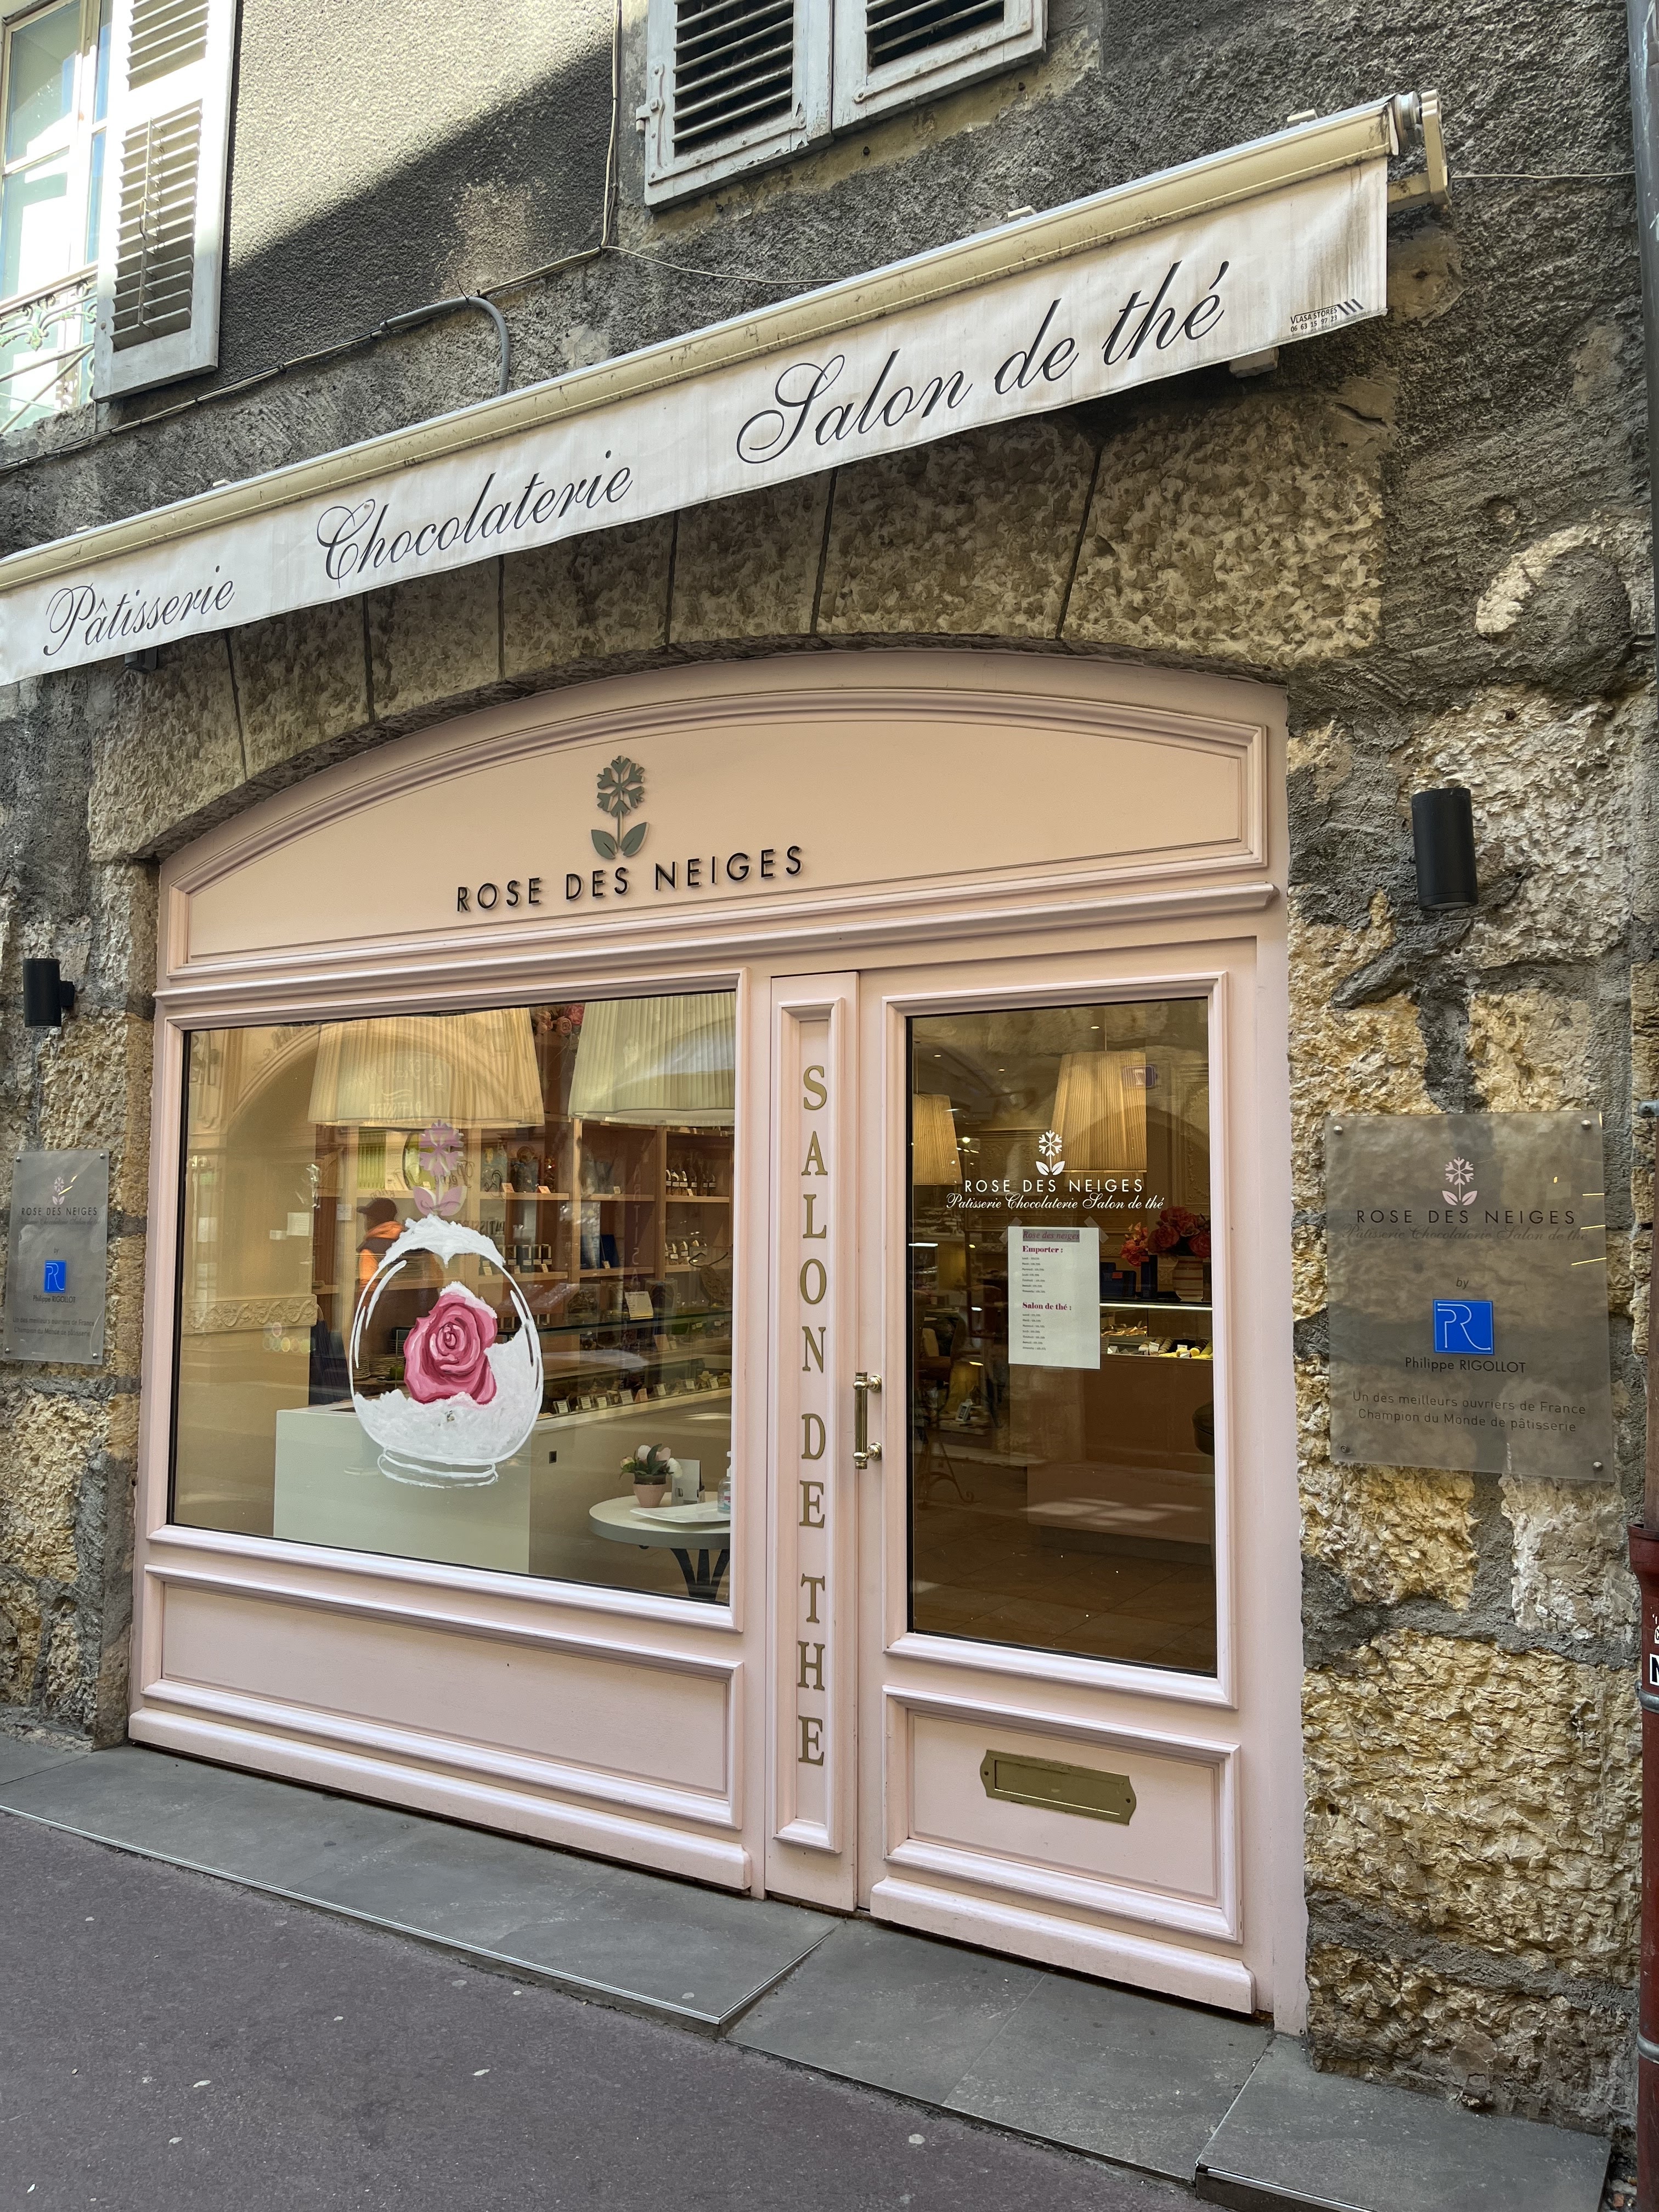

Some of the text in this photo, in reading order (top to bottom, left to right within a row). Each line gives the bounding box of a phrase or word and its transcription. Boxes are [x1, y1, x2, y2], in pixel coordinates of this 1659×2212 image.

[1313, 307, 1338, 319] STORES
[736, 259, 1229, 465] Salon de thé
[317, 450, 633, 589] Chocolaterie
[43, 565, 235, 656] Pâtisserie
[457, 845, 803, 912] ROSE DES NEIGES
[964, 1179, 1142, 1192] ROSE DES NEIGES
[946, 1192, 1165, 1210] Patisserie Chocolaterie Salon de thé
[21, 1207, 97, 1216] ROSE DES NEIGES
[1357, 1210, 1575, 1224] ROSE DES NEIGES
[1057, 1233, 1079, 1241] neiges
[1409, 1223, 1492, 1239] Chocolaterie
[1497, 1224, 1543, 1240] Salon
[1548, 1227, 1563, 1240] de
[1023, 1245, 1059, 1254] Emporter
[1456, 1277, 1469, 1289] by
[52, 1295, 76, 1304] RIGOLLOT
[1406, 1357, 1526, 1373] Philippe RIGOLLOT
[1353, 1391, 1585, 1414] Un des meilleurs ouvriers de France
[797, 1065, 828, 1766] SALON DE THE
[1358, 1408, 1576, 1431] Champion du Monde de pâtisserie
